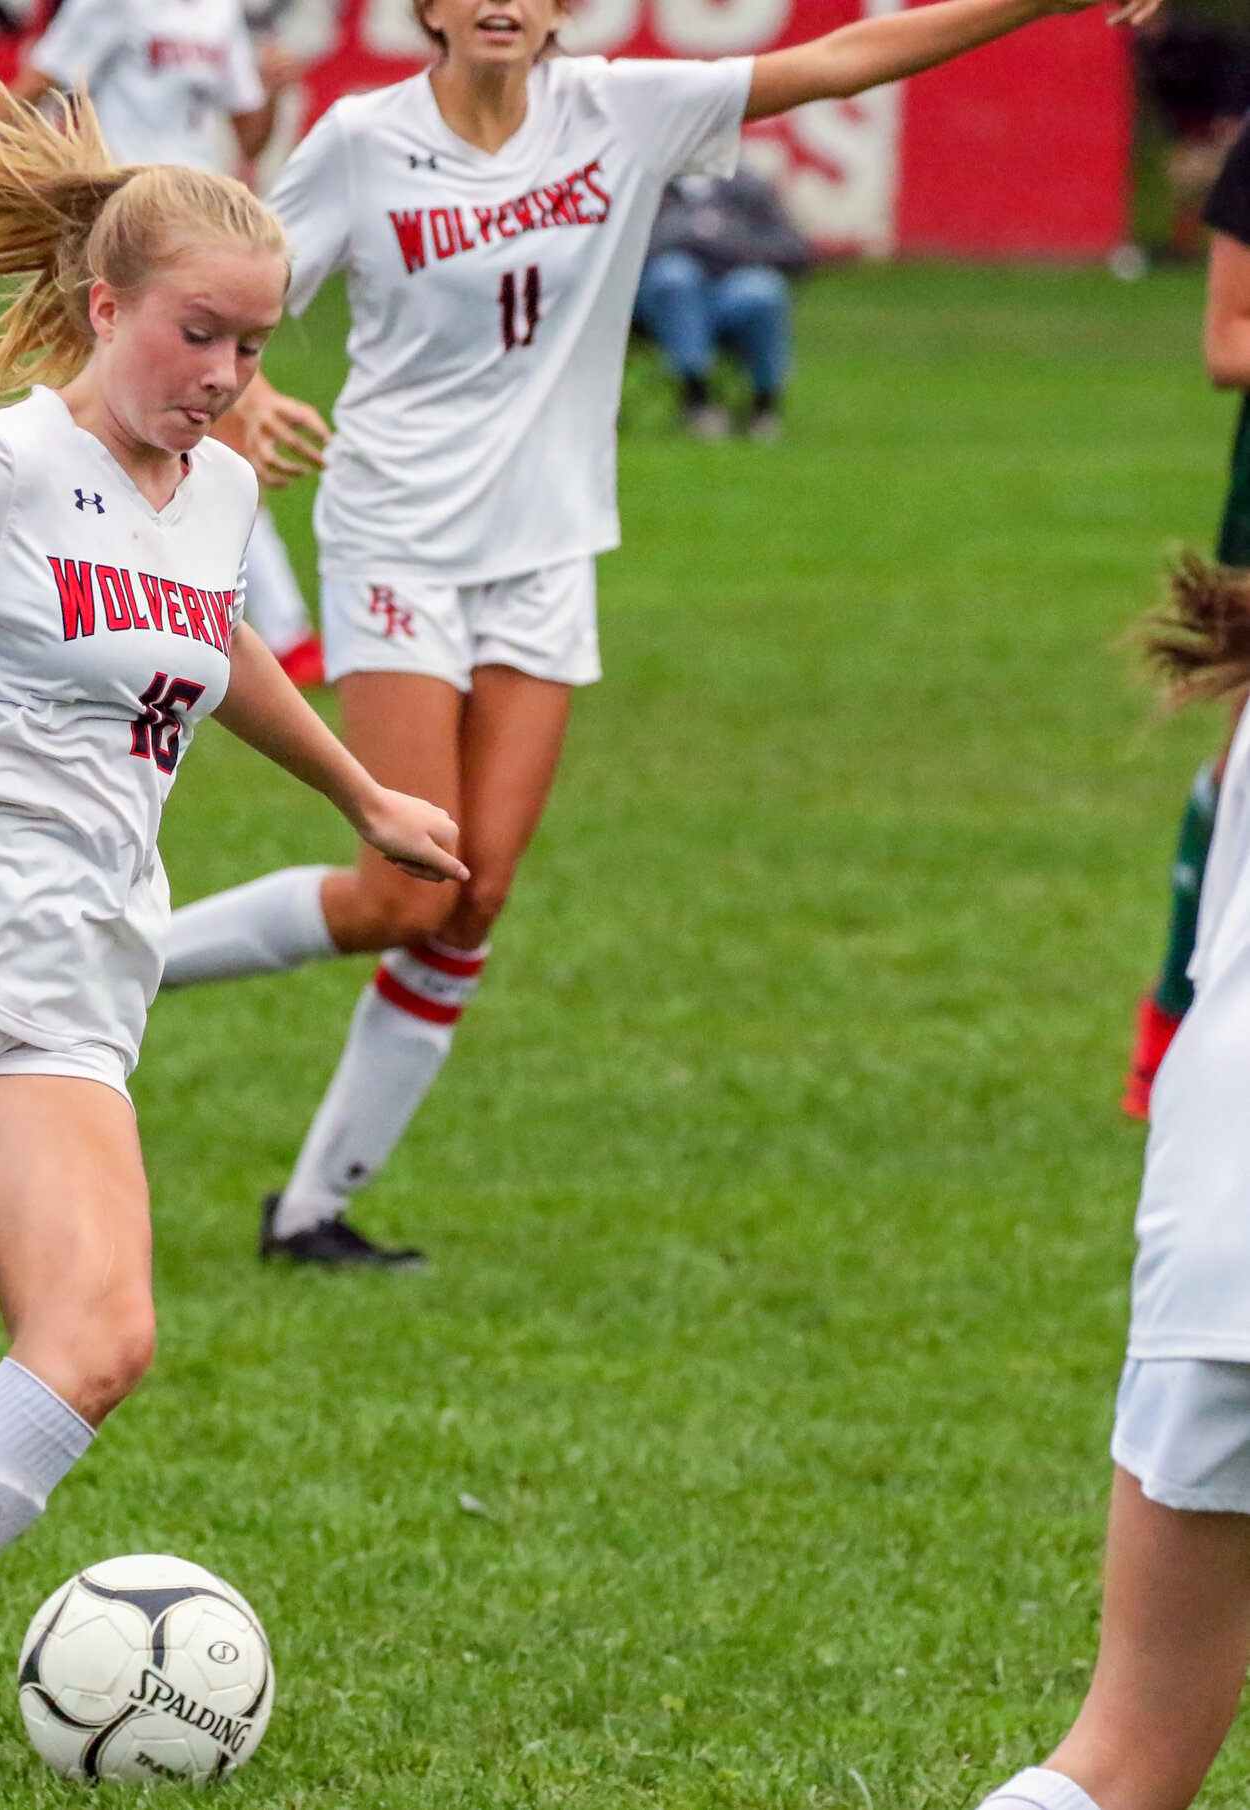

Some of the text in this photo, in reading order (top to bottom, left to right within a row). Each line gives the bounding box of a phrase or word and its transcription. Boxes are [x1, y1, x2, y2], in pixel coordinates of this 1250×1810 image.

[498, 263, 541, 353] 11
[129, 671, 206, 775] 16
[129, 1669, 252, 1755] SPALDING
